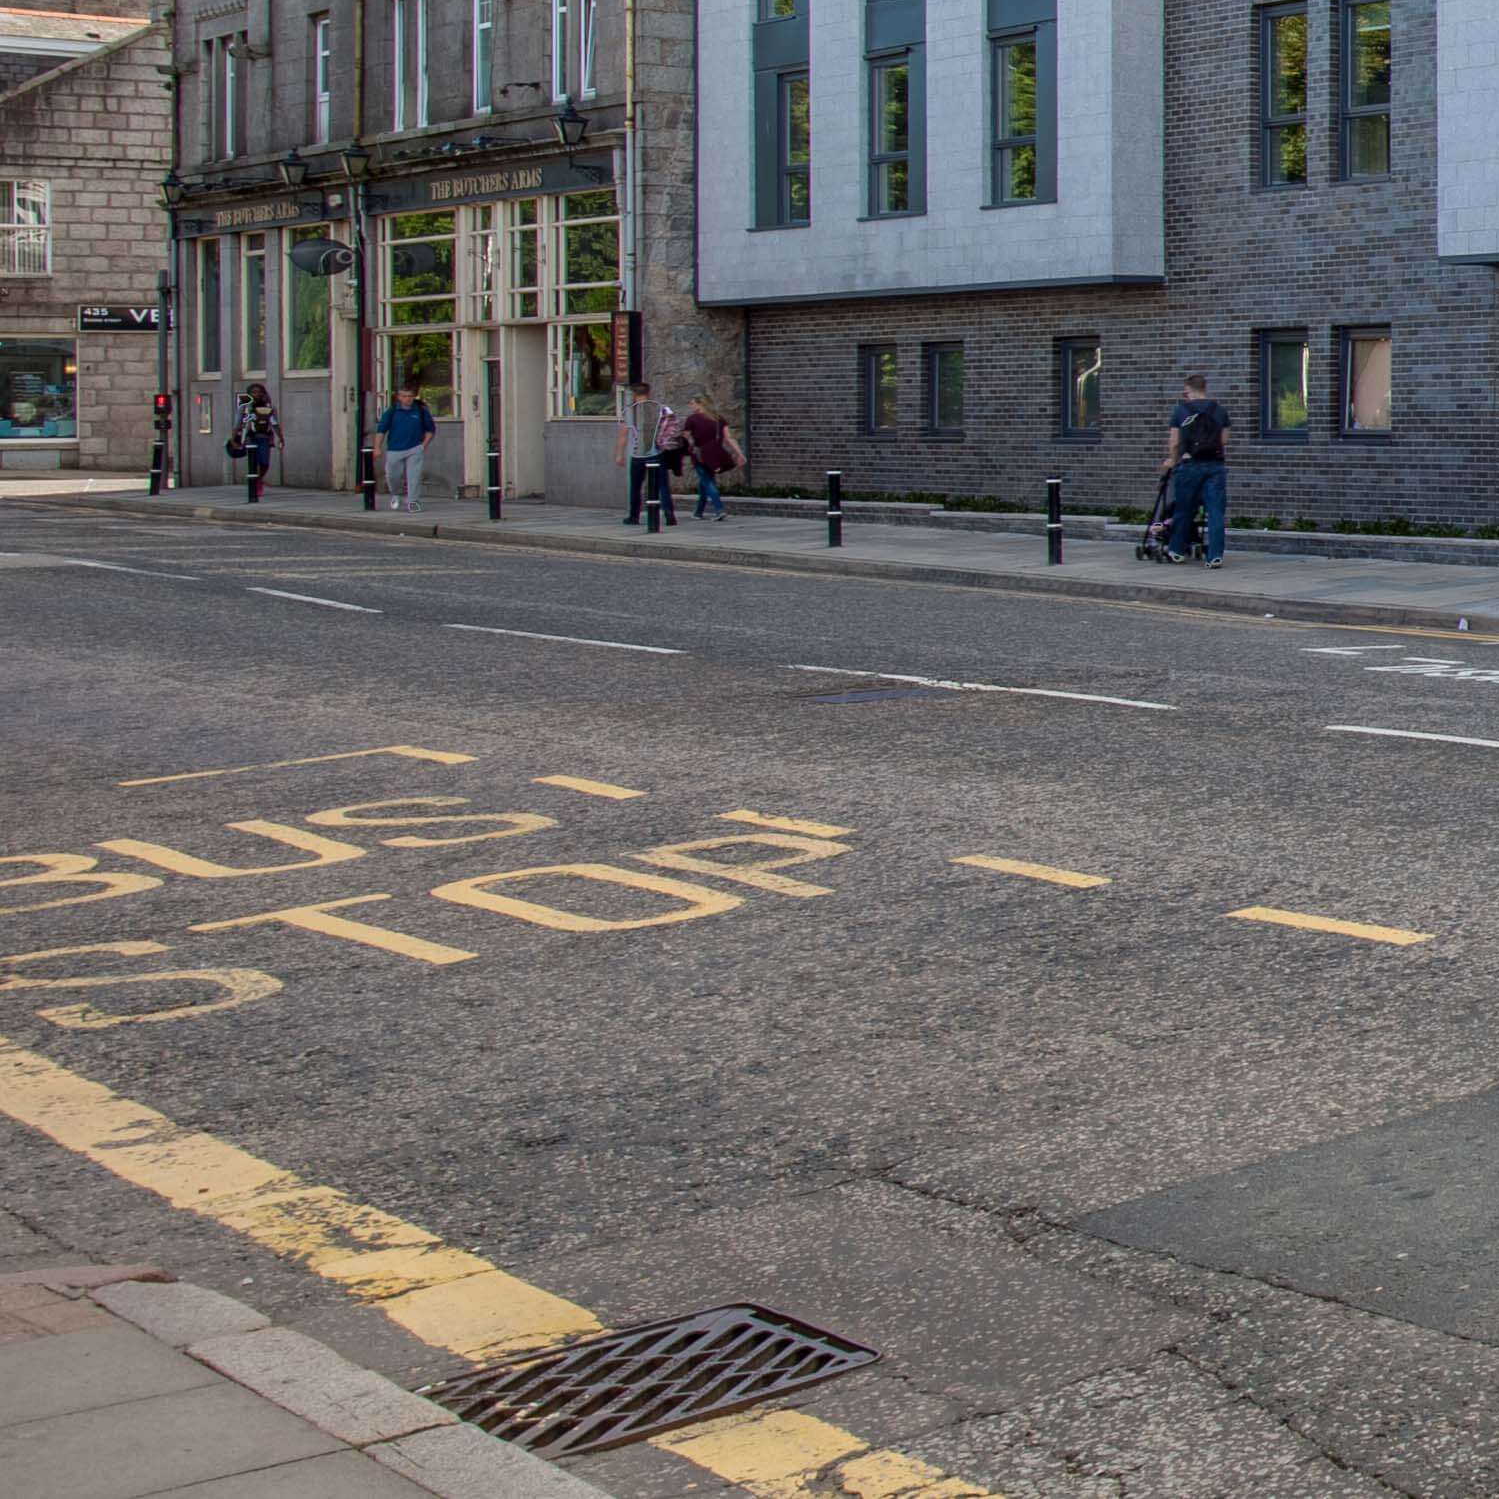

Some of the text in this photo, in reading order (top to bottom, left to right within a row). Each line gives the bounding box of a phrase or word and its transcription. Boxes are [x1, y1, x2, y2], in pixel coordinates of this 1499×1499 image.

[431, 168, 543, 200] THE BUTCHERS ARMS
[83, 308, 109, 316] 435
[0, 795, 558, 913] BUS
[0, 832, 856, 1030] STOP
